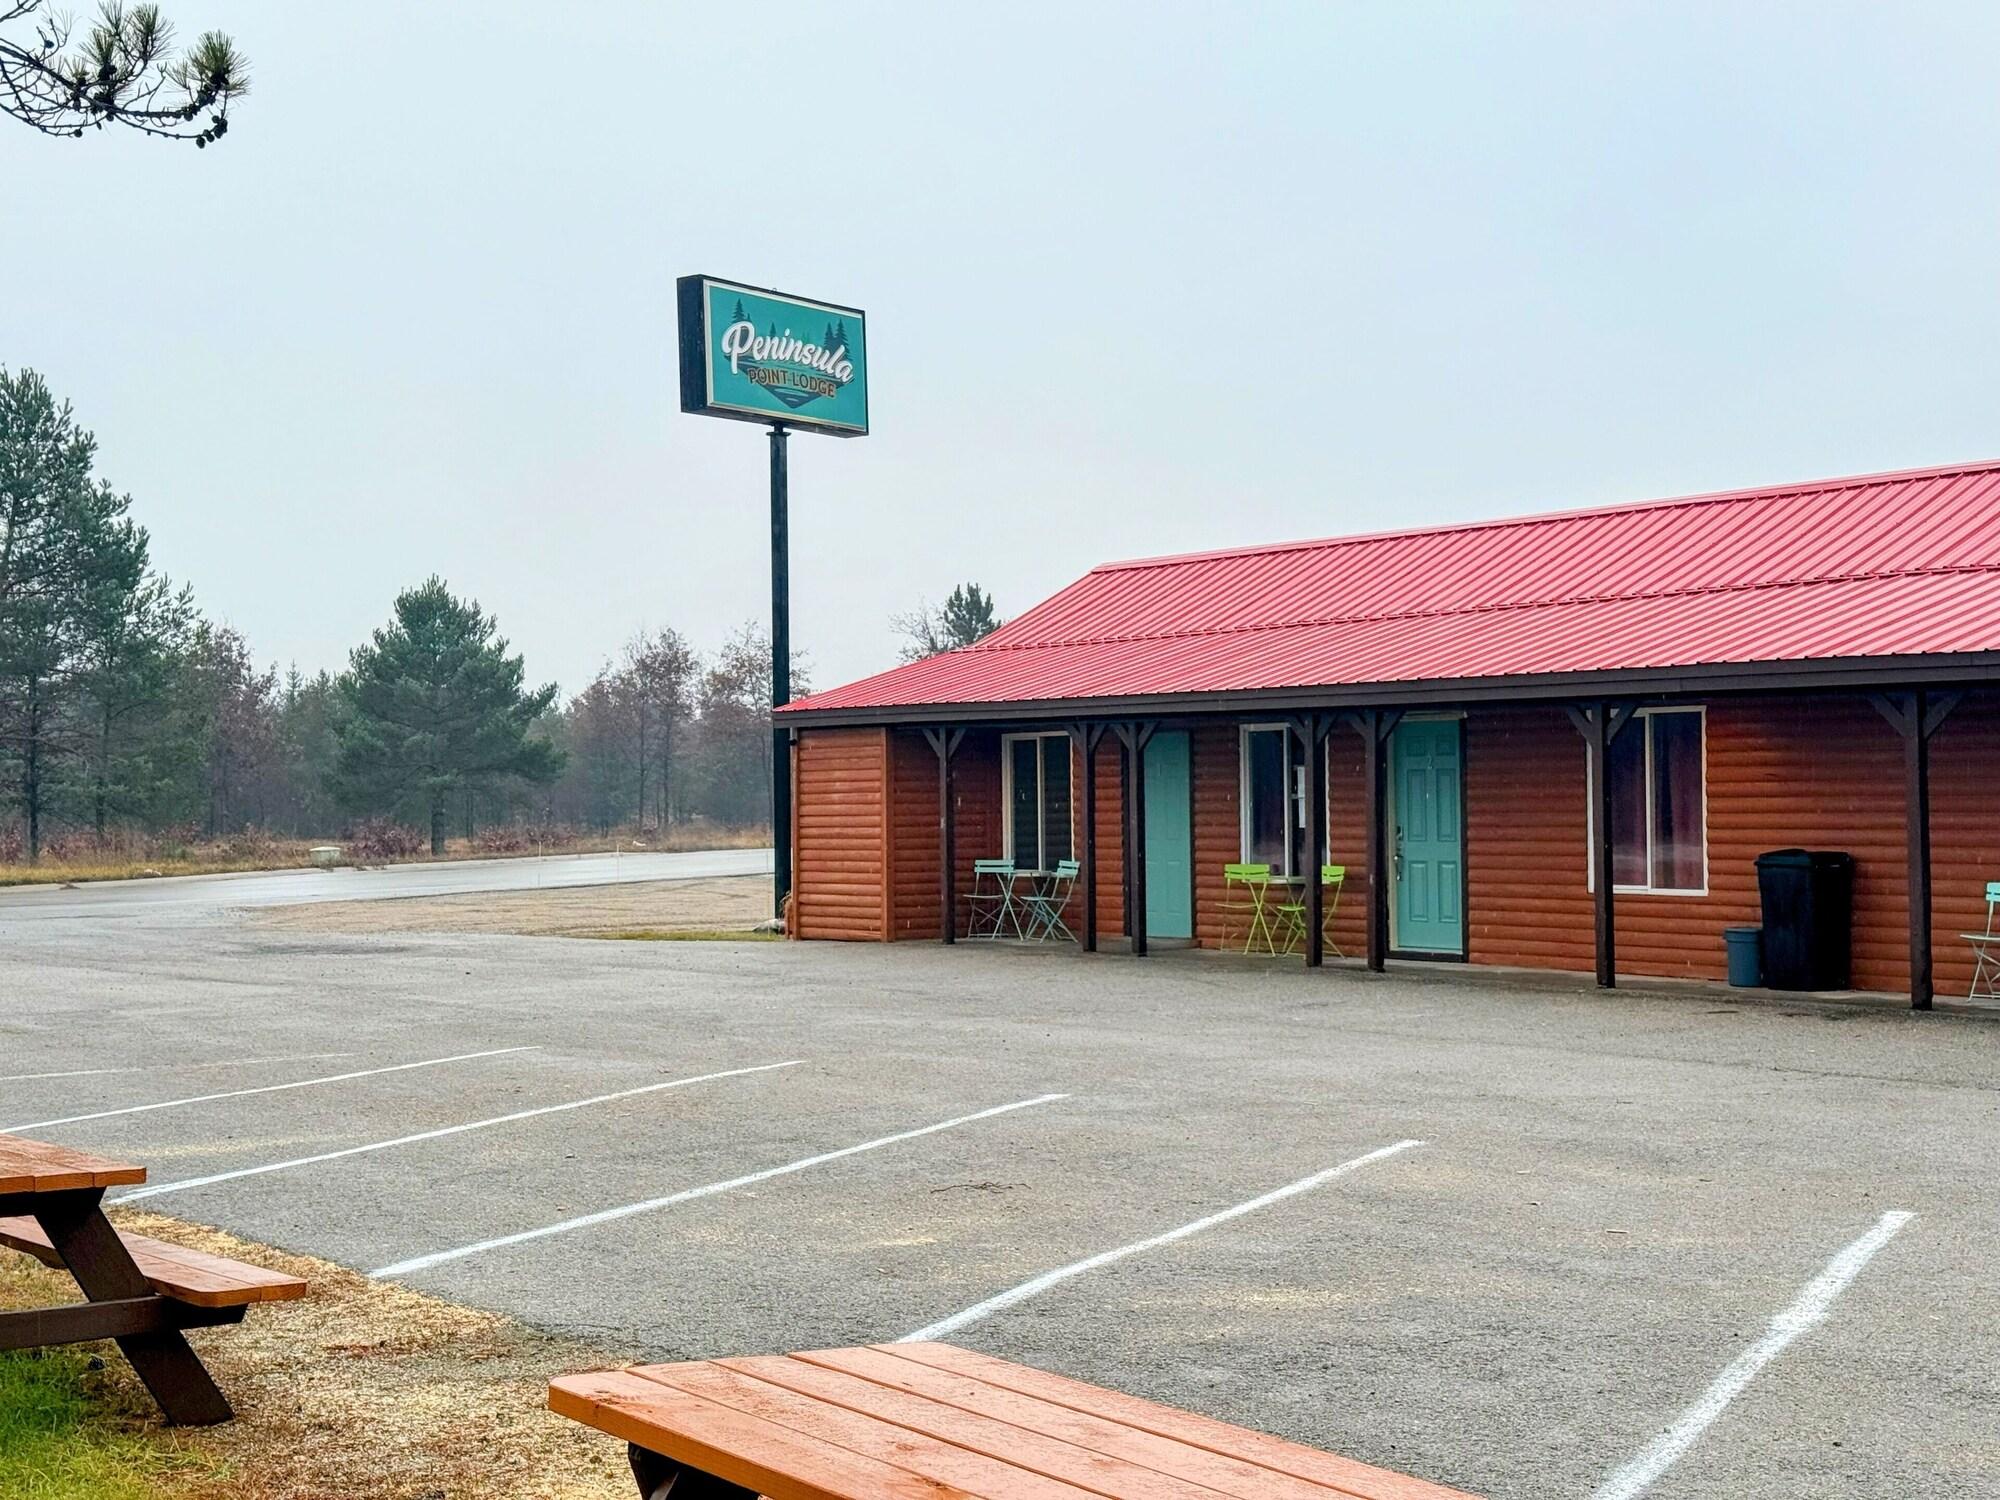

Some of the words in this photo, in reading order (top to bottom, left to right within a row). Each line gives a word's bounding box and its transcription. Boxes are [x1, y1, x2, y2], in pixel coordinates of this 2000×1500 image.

[722, 321, 853, 382] Peninsula
[748, 367, 788, 385] POINT
[793, 374, 835, 397] LODGE
